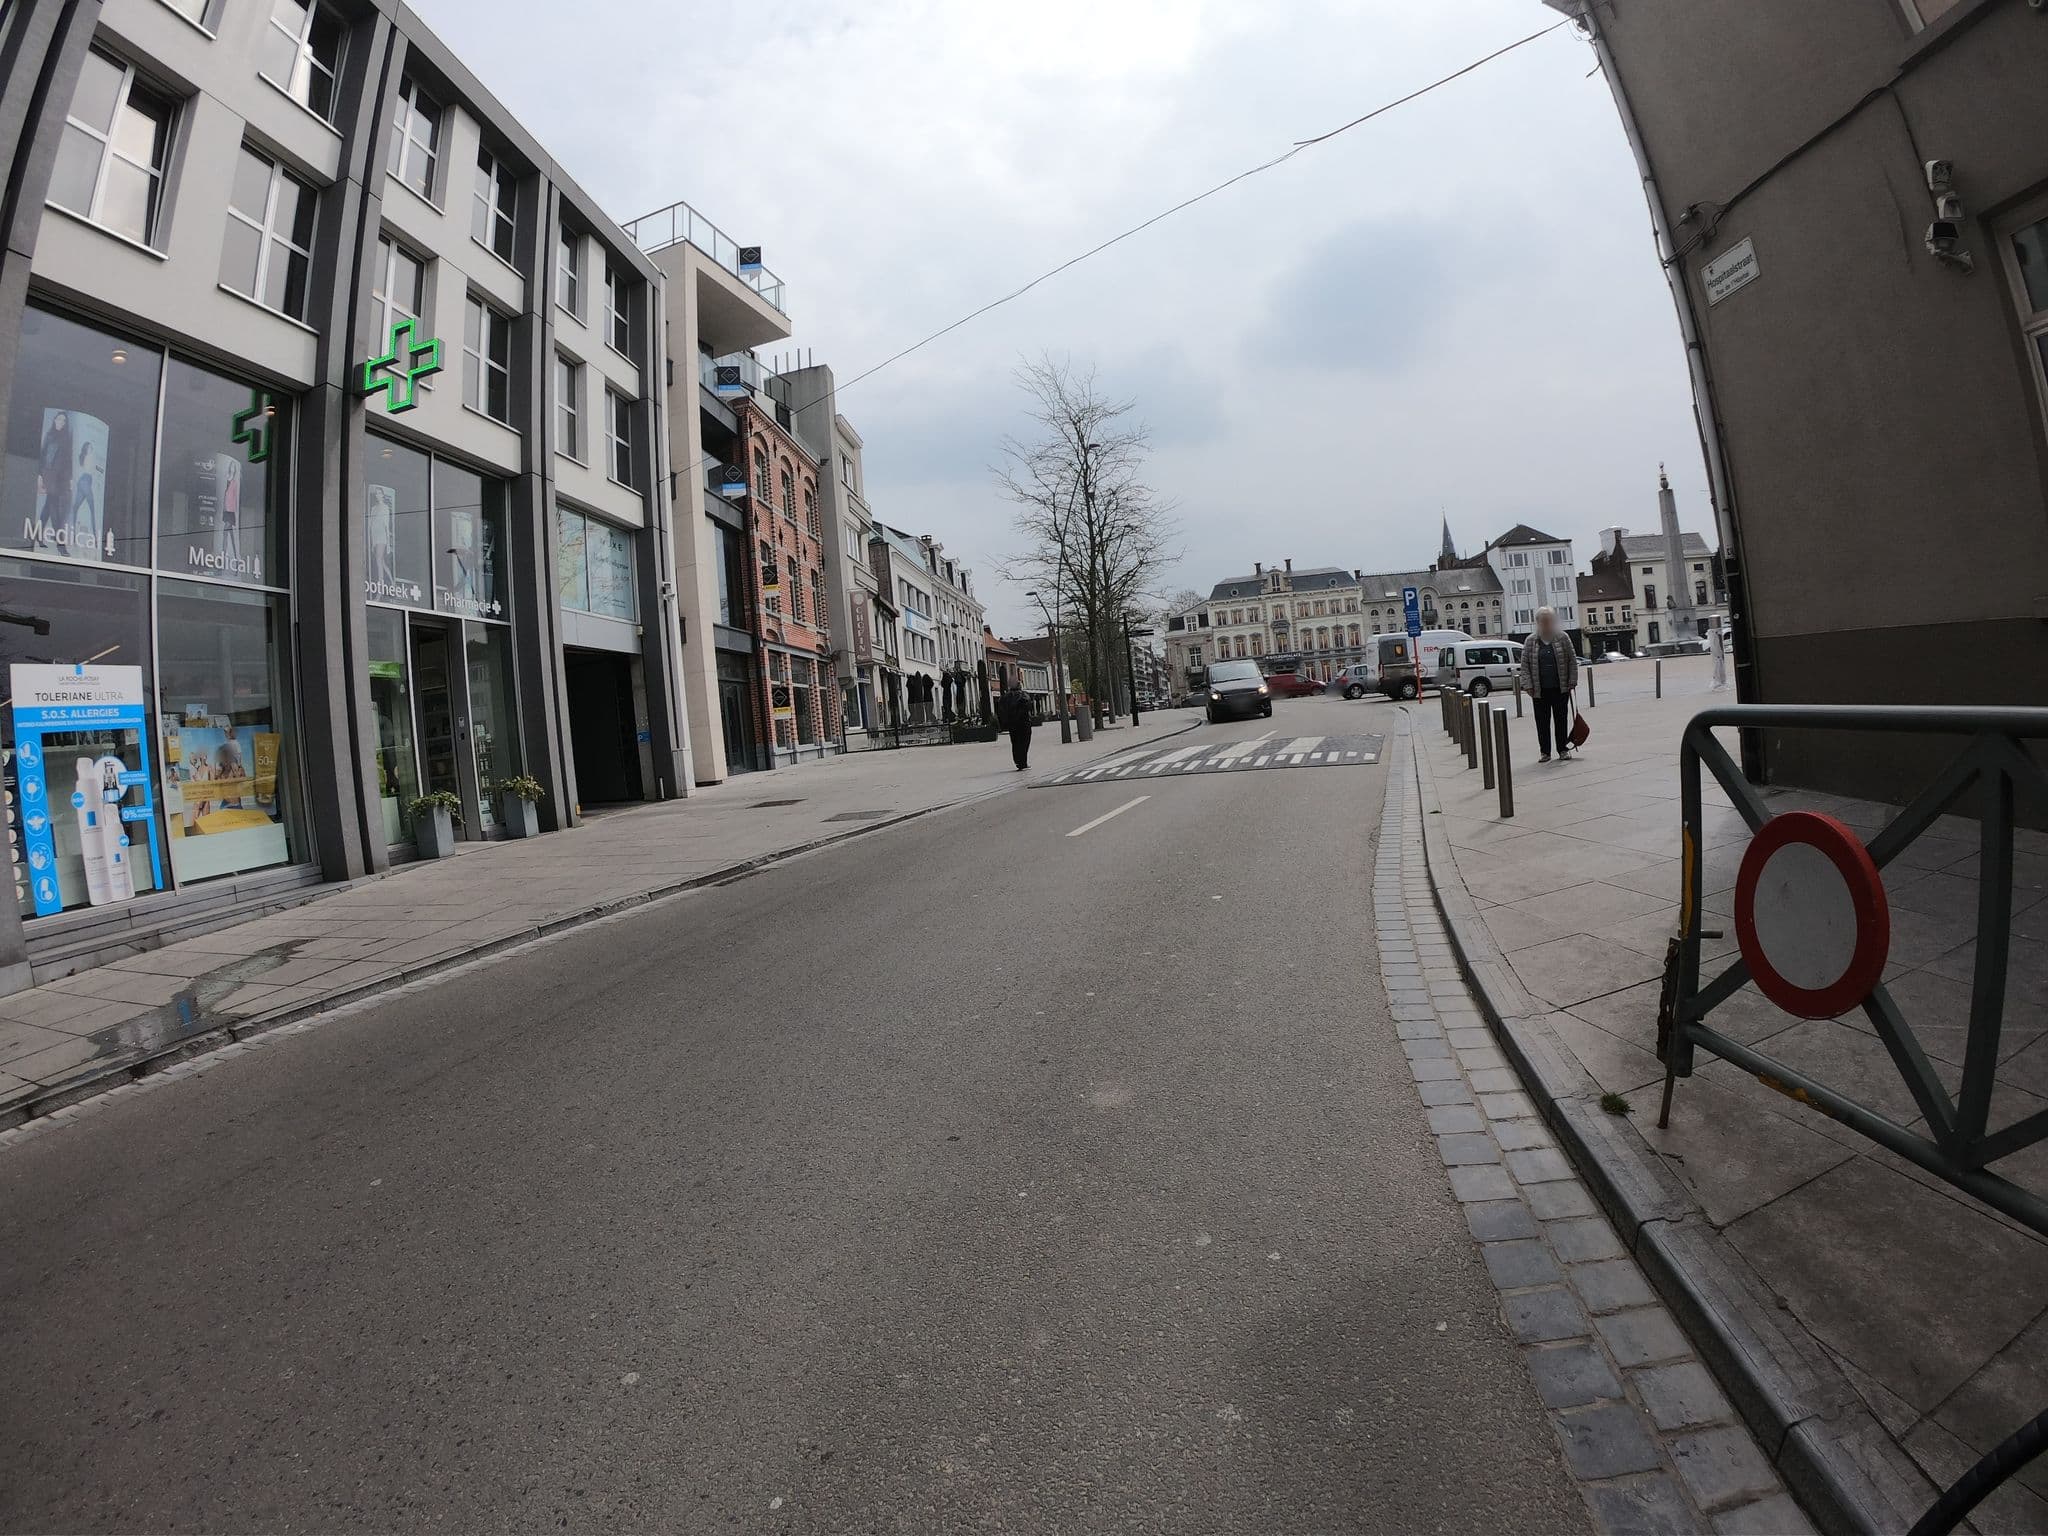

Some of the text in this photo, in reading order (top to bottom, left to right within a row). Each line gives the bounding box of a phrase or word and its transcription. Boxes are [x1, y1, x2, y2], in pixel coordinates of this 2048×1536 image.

[1707, 254, 1753, 289] Hospitaalstraat
[23, 517, 101, 551] Medical
[188, 546, 250, 574] Medical
[444, 592, 492, 613] Pharmacie
[1405, 590, 1415, 606] P
[855, 606, 867, 652] CHOPIN
[35, 691, 124, 702] TOLERIANE ULTRA
[41, 708, 120, 720] S.O.S. ALLERGIES
[258, 755, 274, 766] 50+
[123, 809, 137, 819] 0%
